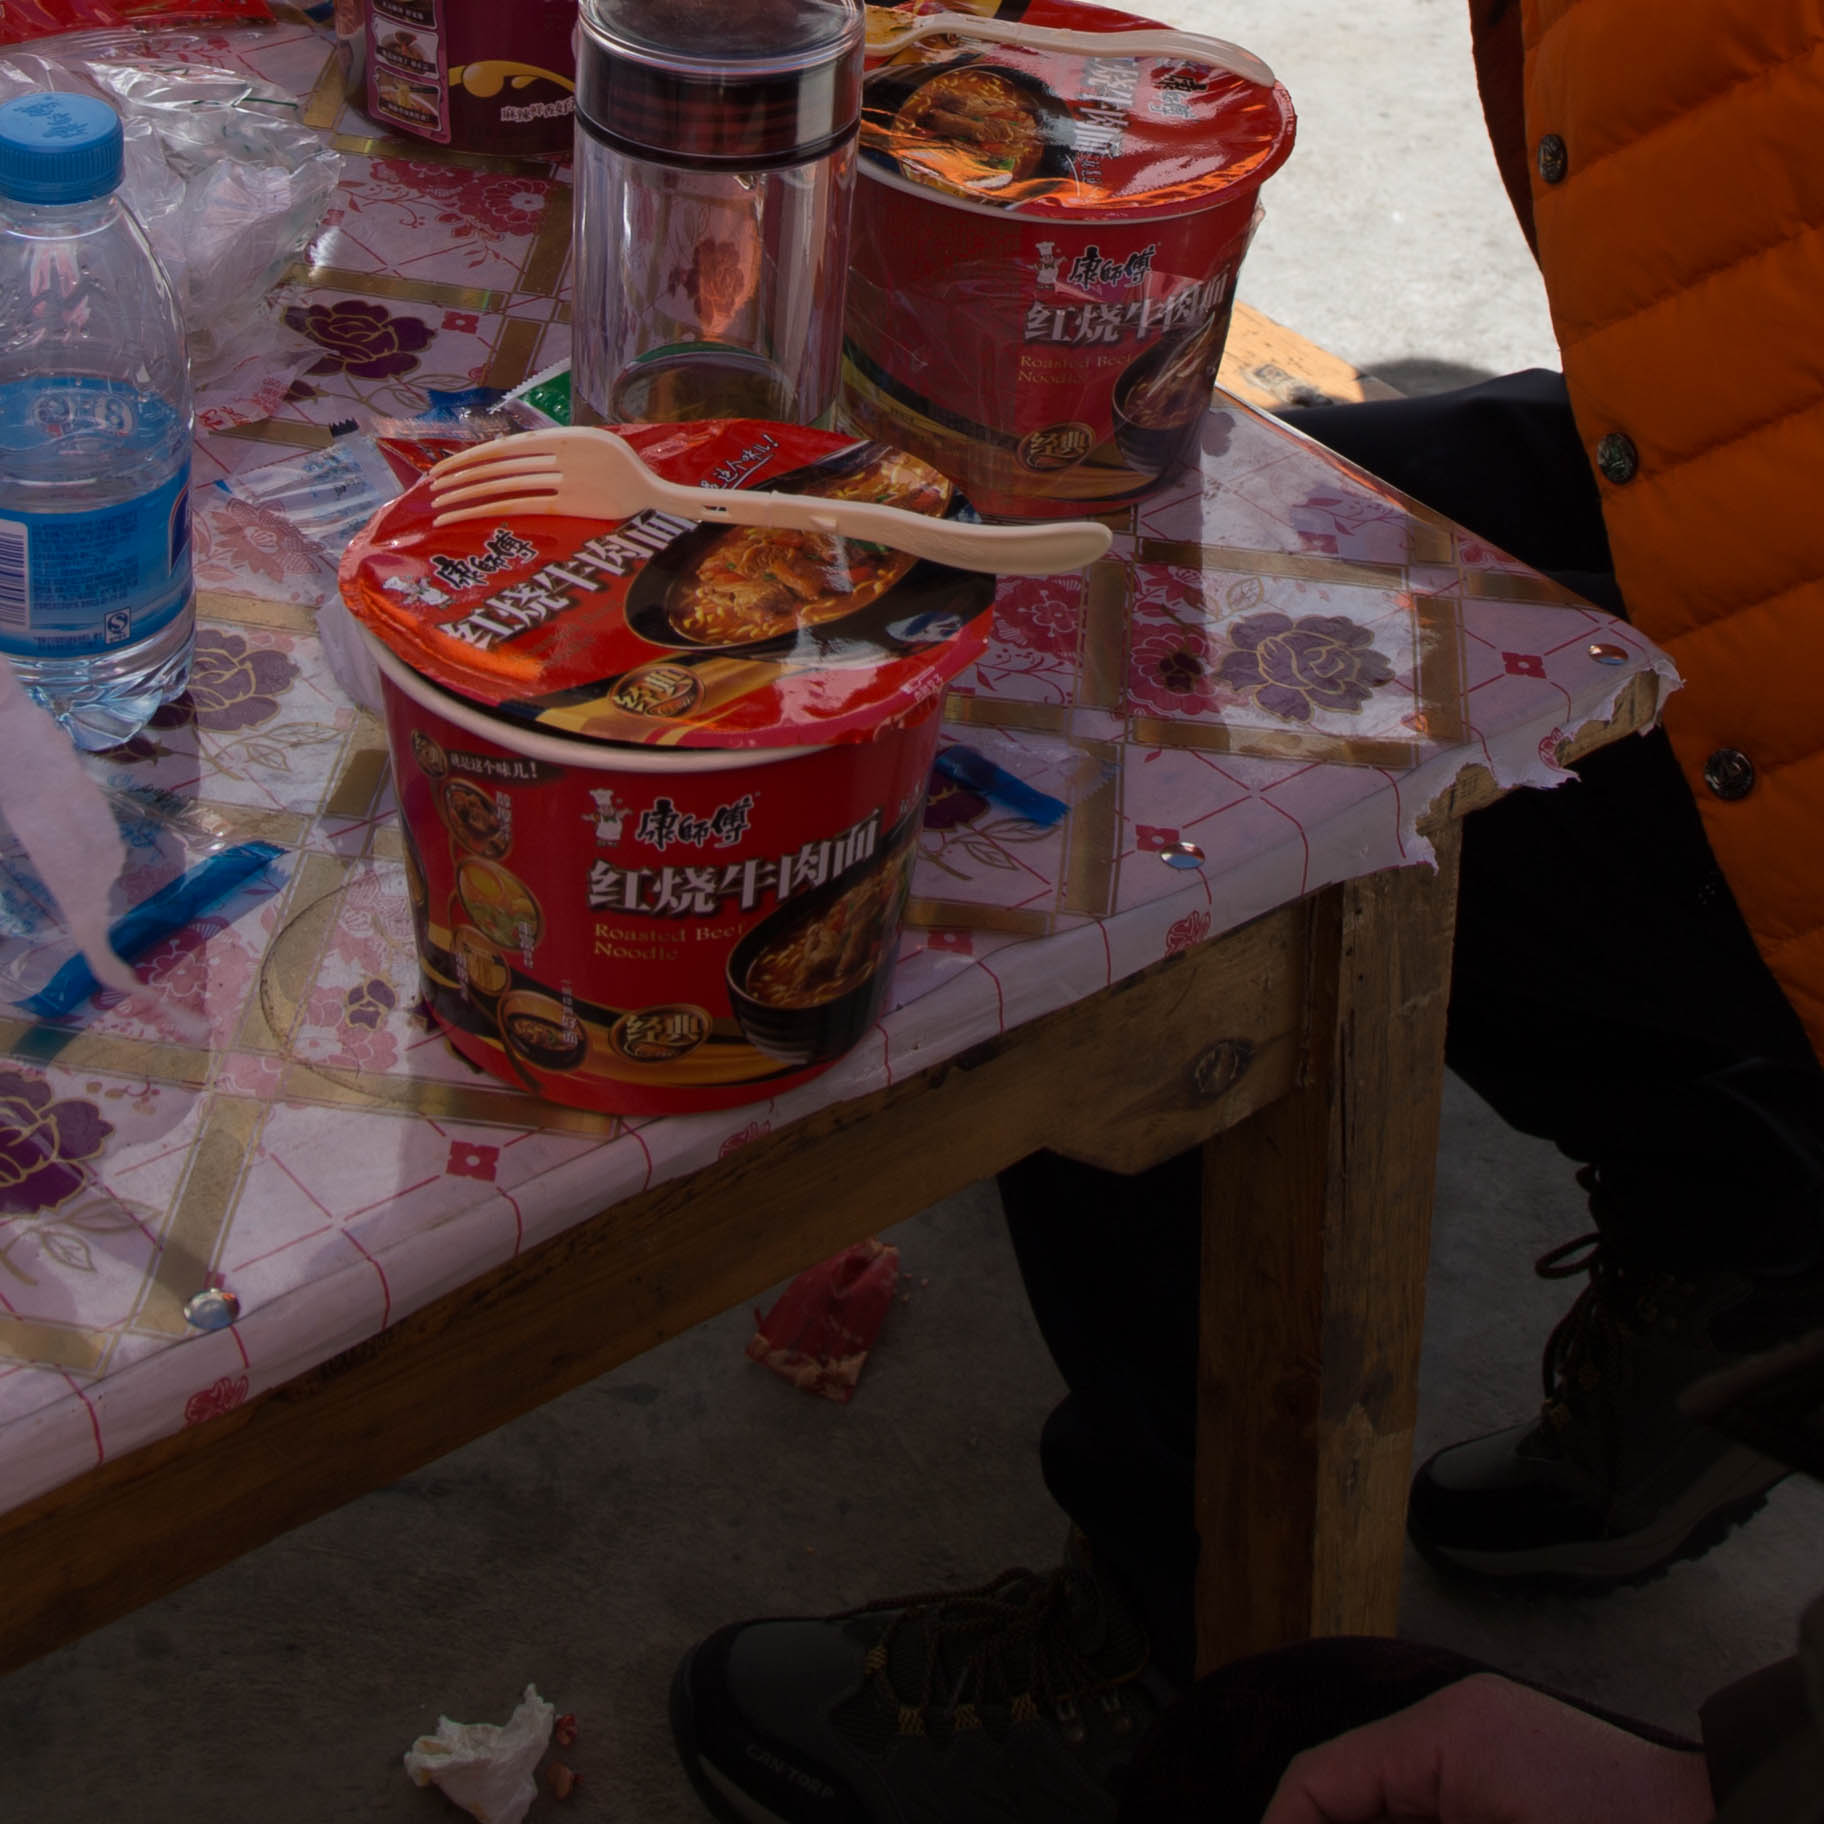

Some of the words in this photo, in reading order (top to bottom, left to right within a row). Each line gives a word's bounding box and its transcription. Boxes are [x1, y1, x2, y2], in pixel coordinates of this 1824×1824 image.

[1024, 268, 1229, 344] 红烧牛肉面
[1029, 430, 1088, 456] 经典
[437, 509, 703, 651] 红烧牛肉面
[612, 669, 694, 715] 经典
[588, 810, 880, 916] 红烧牛肉面
[593, 940, 679, 961] Noodle
[594, 923, 686, 943] Roasted
[695, 921, 745, 942] Beef
[625, 1014, 700, 1043] 经典
